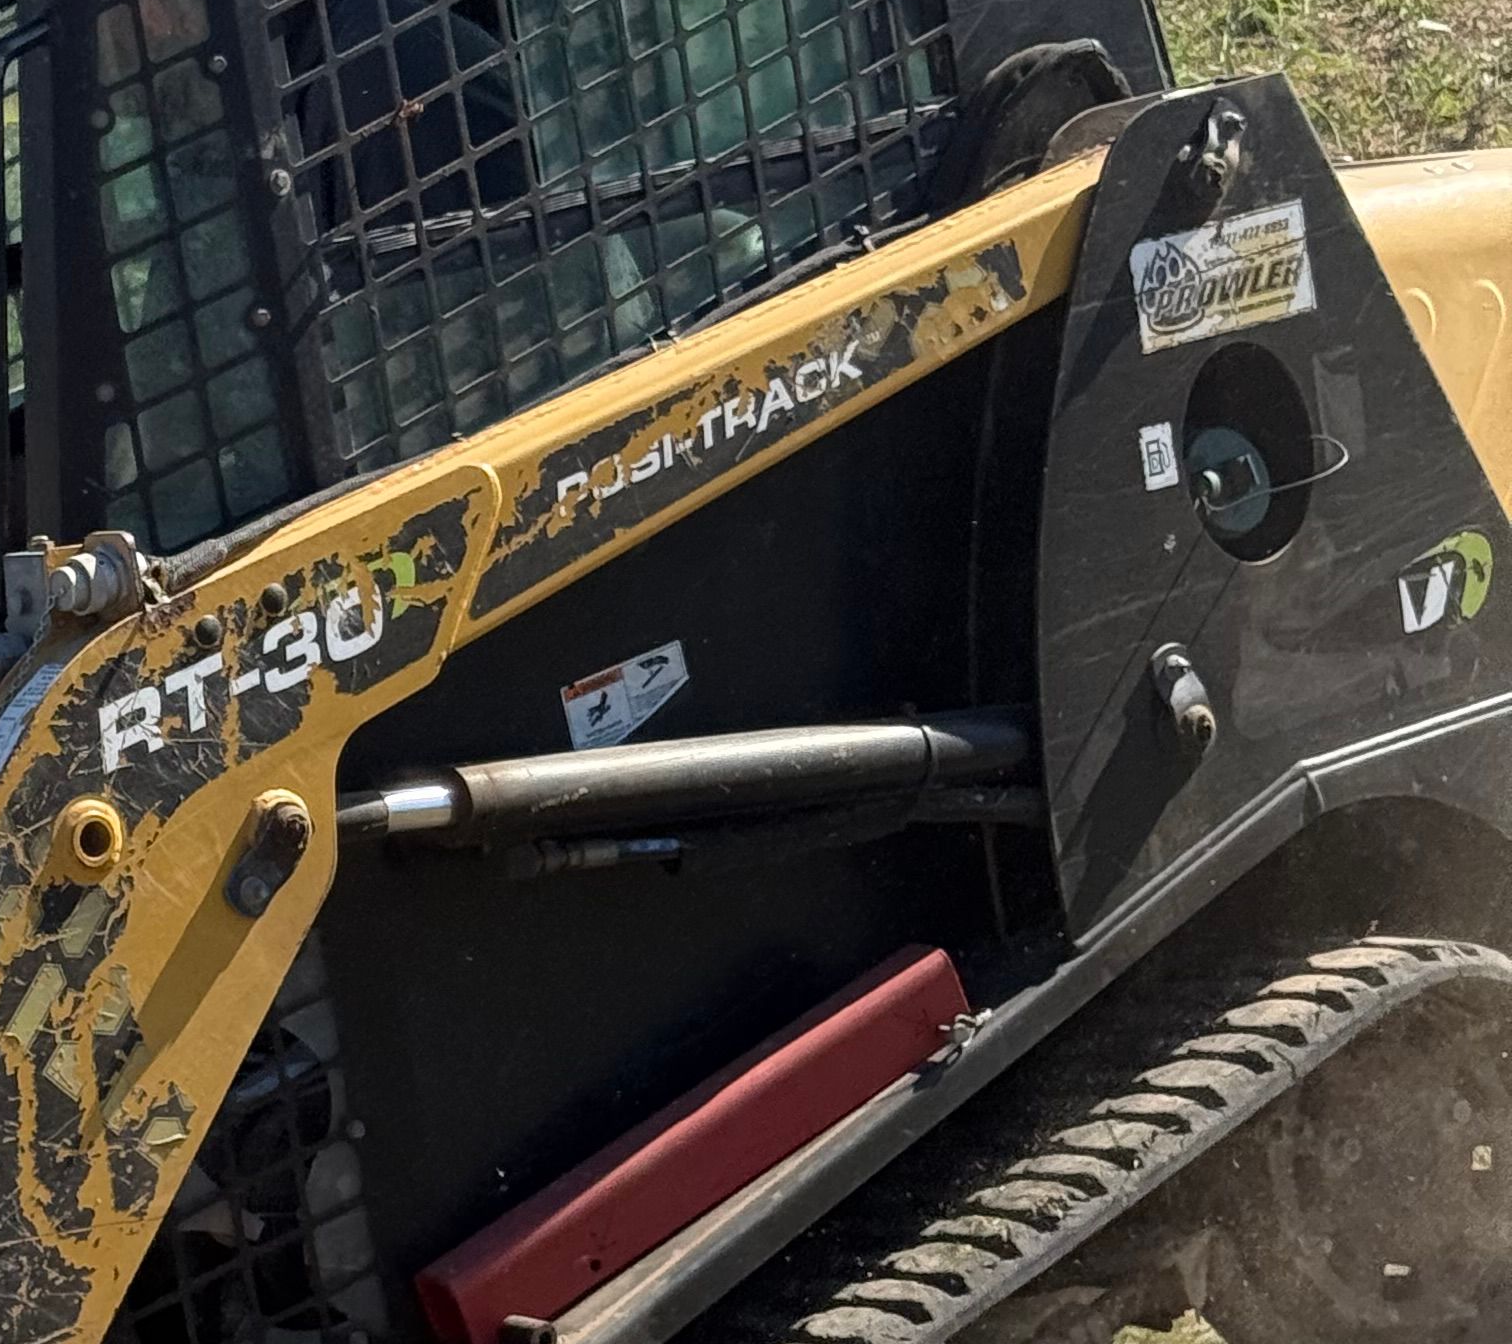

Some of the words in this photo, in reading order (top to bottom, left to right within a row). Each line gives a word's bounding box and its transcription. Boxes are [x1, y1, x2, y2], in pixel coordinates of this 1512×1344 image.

[1154, 253, 1303, 321] PROWLER
[557, 340, 863, 518] POSI-TRACK
[99, 583, 383, 774] RT-30
